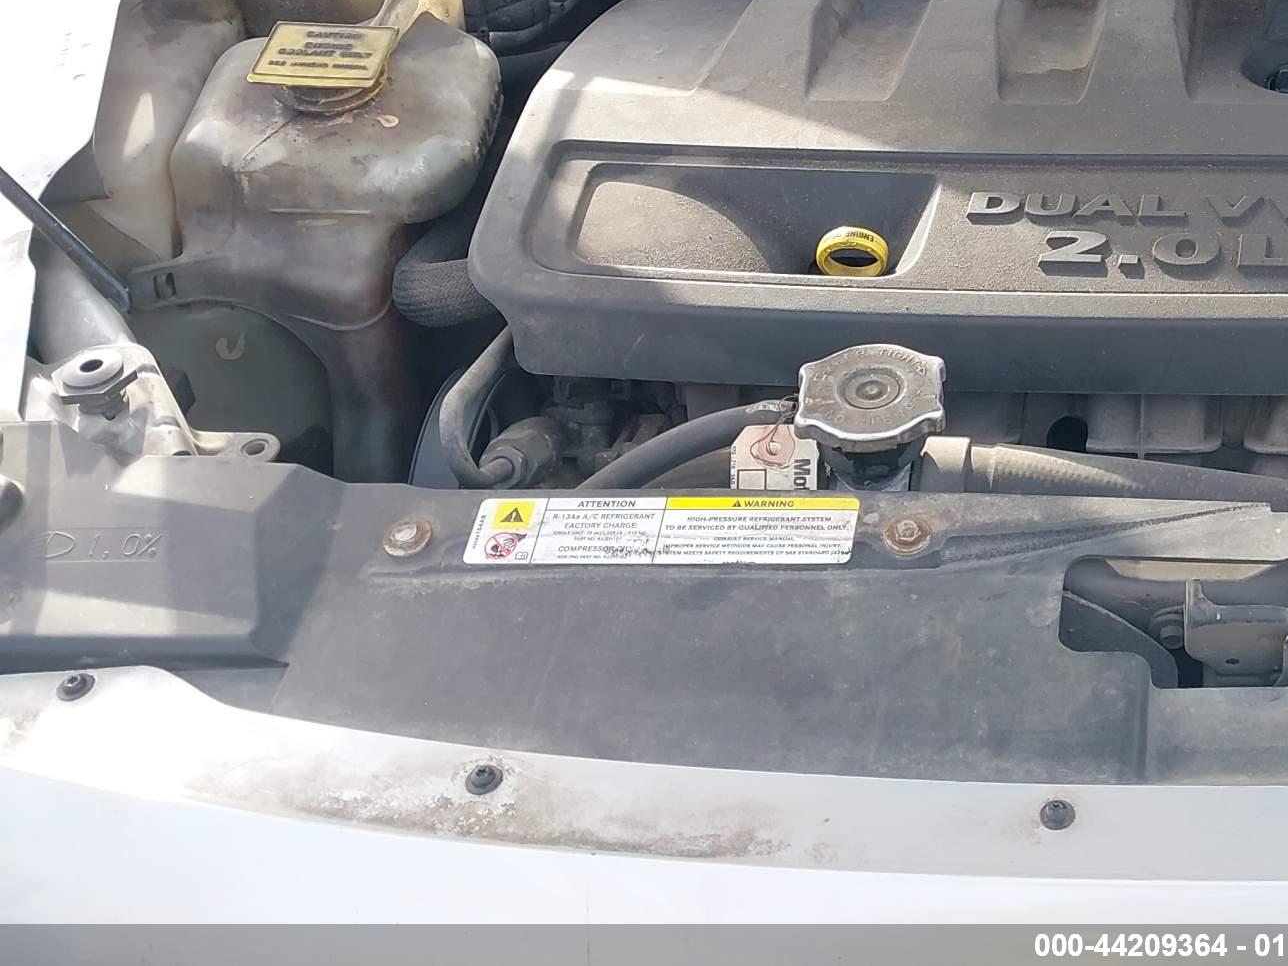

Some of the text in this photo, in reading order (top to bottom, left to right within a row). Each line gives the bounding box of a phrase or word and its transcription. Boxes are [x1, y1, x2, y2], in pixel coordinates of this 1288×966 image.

[967, 192, 1189, 224] DUAL
[577, 500, 636, 508] ATTENTION
[744, 500, 795, 509] WARNING
[582, 513, 599, 521] A/C
[558, 545, 615, 553] COMPRESSOR
